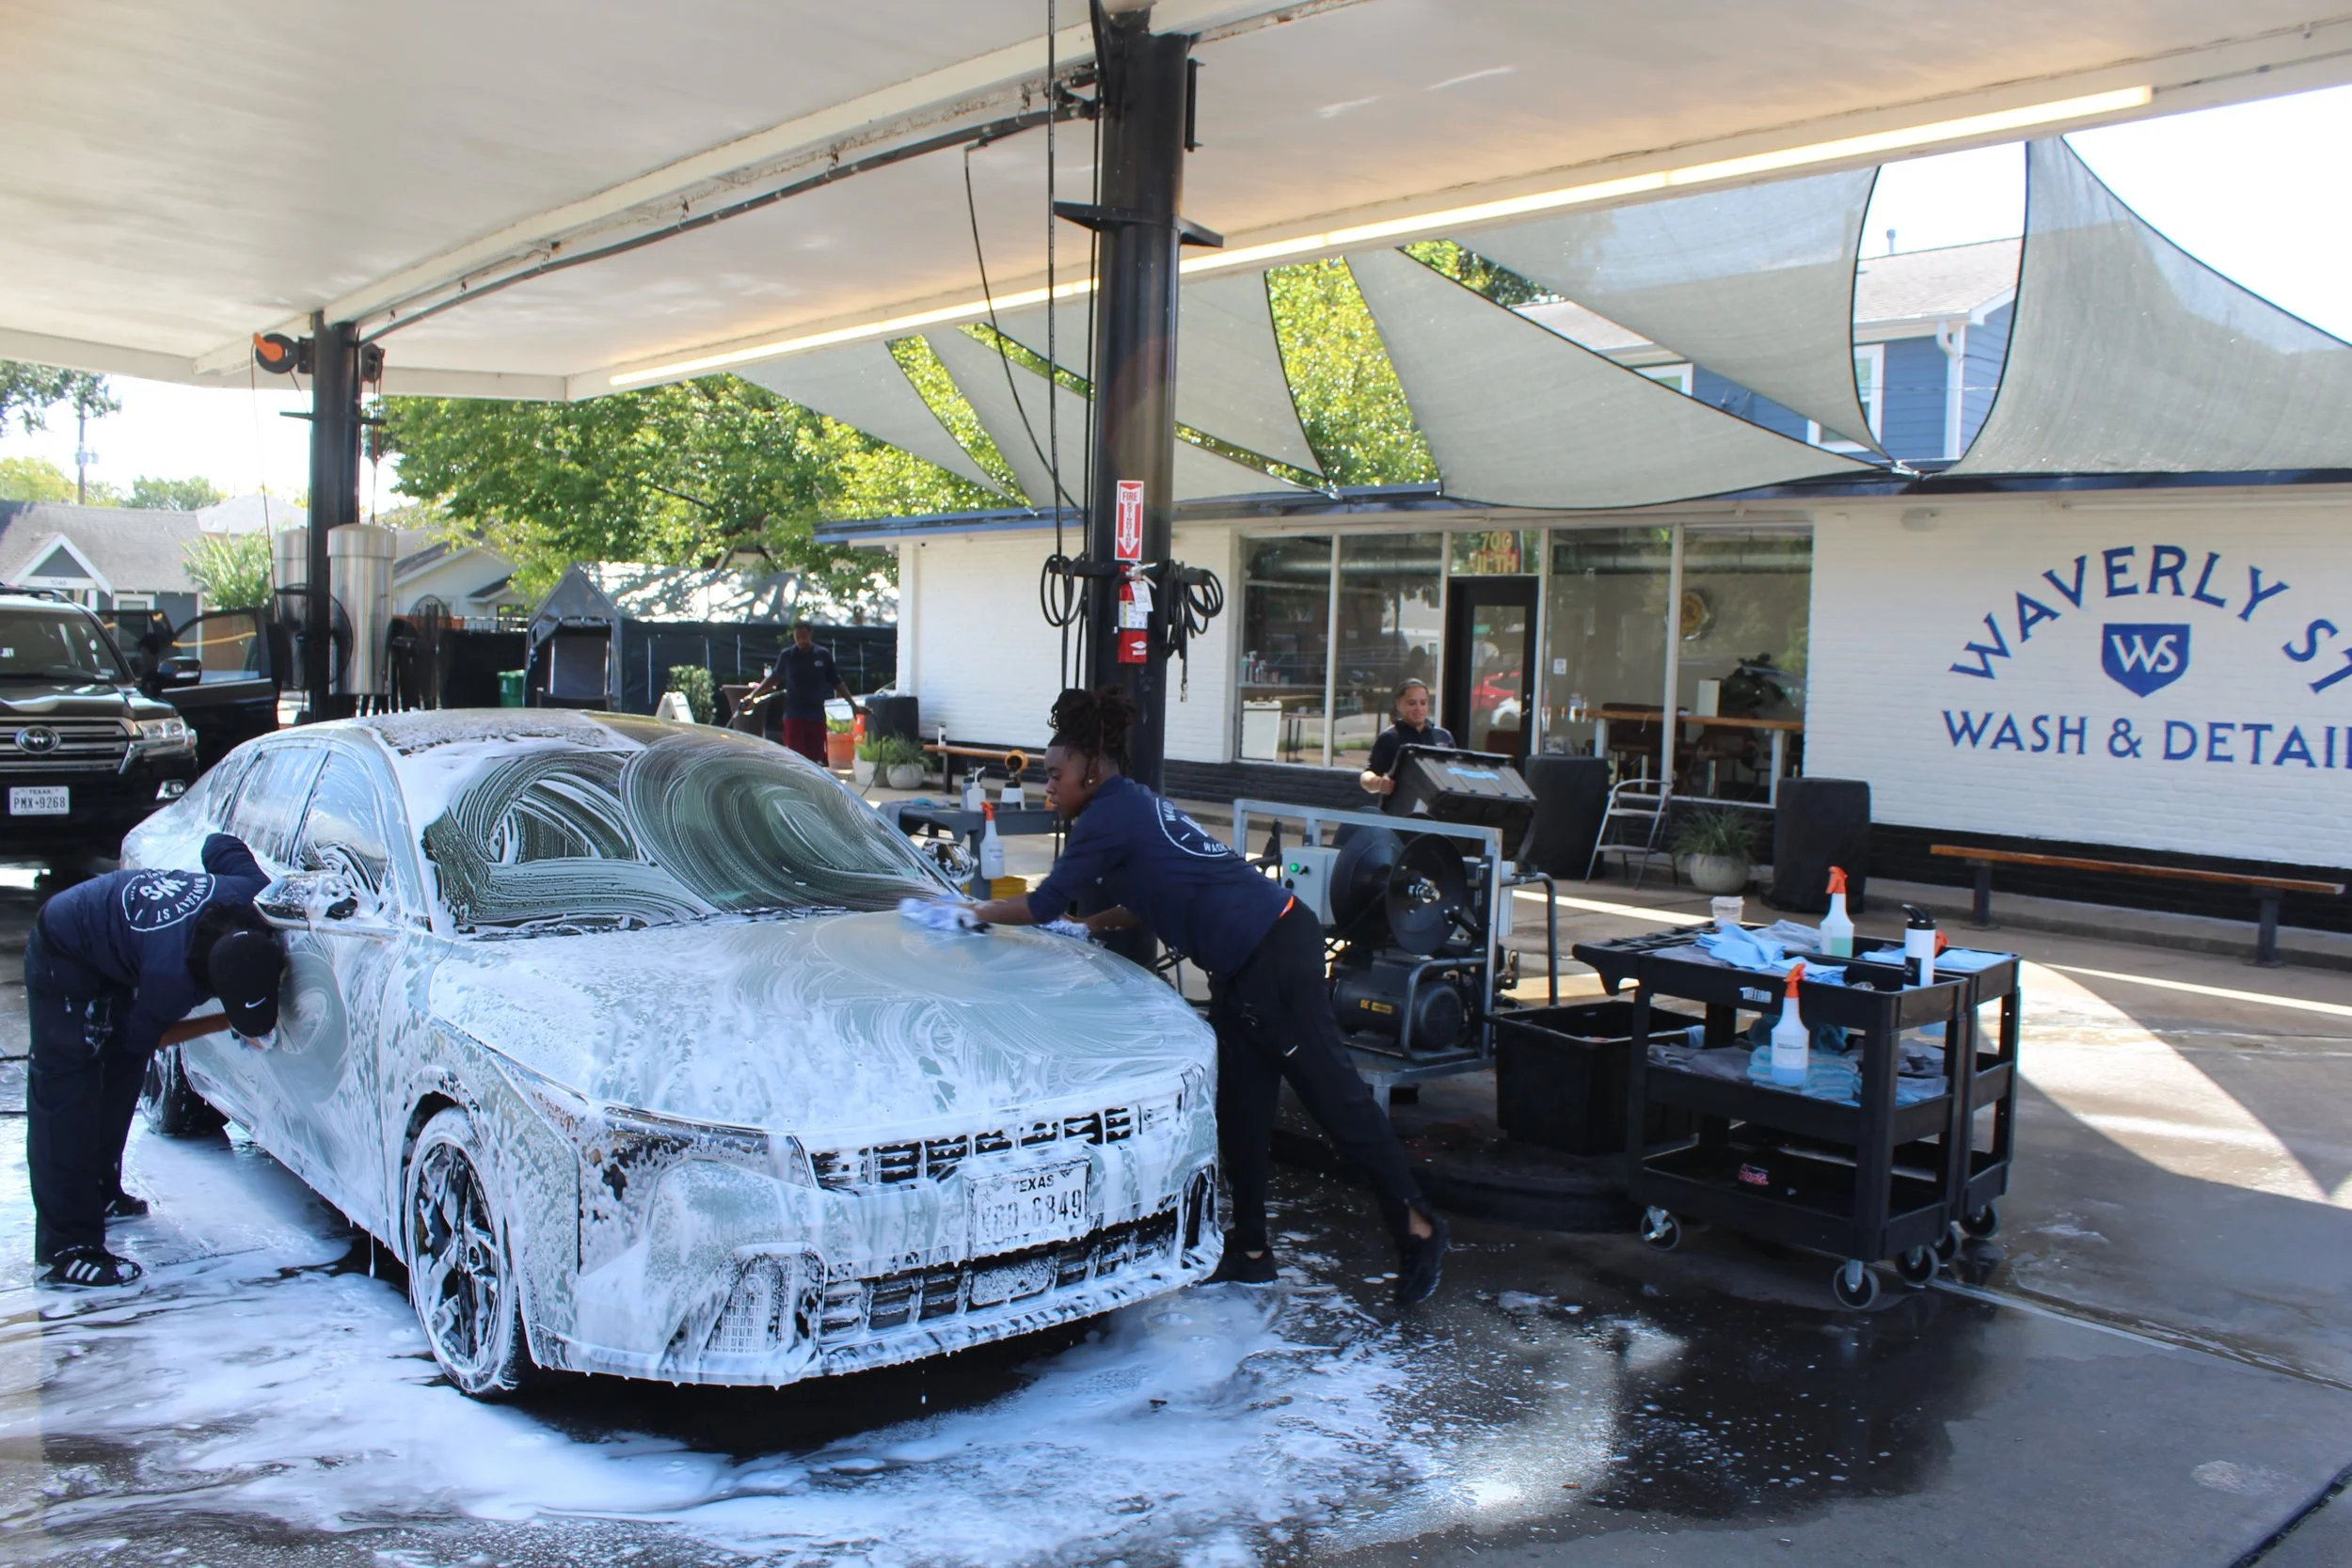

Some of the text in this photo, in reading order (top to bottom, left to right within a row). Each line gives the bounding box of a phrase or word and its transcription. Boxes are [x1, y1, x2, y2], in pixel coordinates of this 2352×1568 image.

[1122, 491, 1137, 501] FIRE
[1947, 544, 2290, 680] WAVERLY
[2110, 634, 2180, 673] WS
[1942, 710, 2089, 756] WASH
[2107, 718, 2142, 758] &
